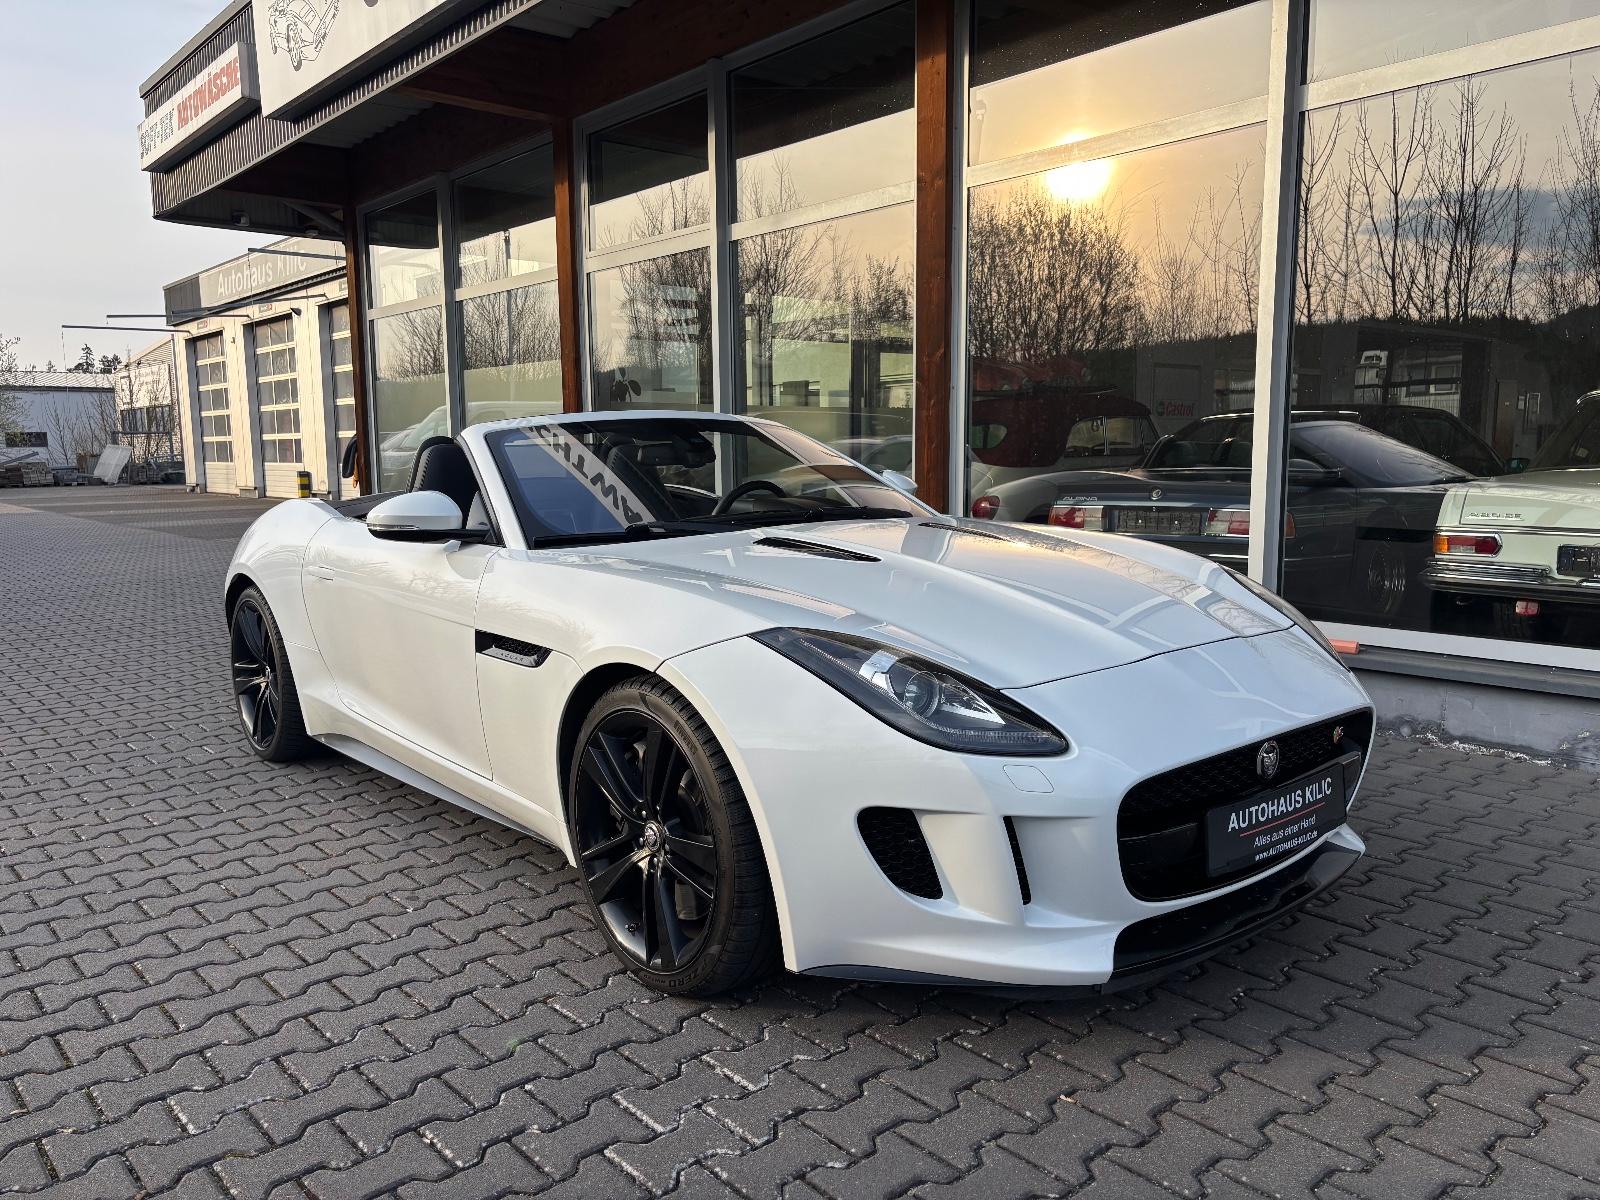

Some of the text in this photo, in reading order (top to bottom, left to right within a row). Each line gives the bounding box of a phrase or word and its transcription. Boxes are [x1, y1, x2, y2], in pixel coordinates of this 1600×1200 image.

[177, 56, 240, 131] AUTOWÄSCHE
[217, 261, 273, 298] Autohaus
[1165, 400, 1196, 416] Castrol
[1227, 777, 1332, 832] AUTOHAUS KILIC
[1253, 814, 1316, 848] Alles aus einer Hand
